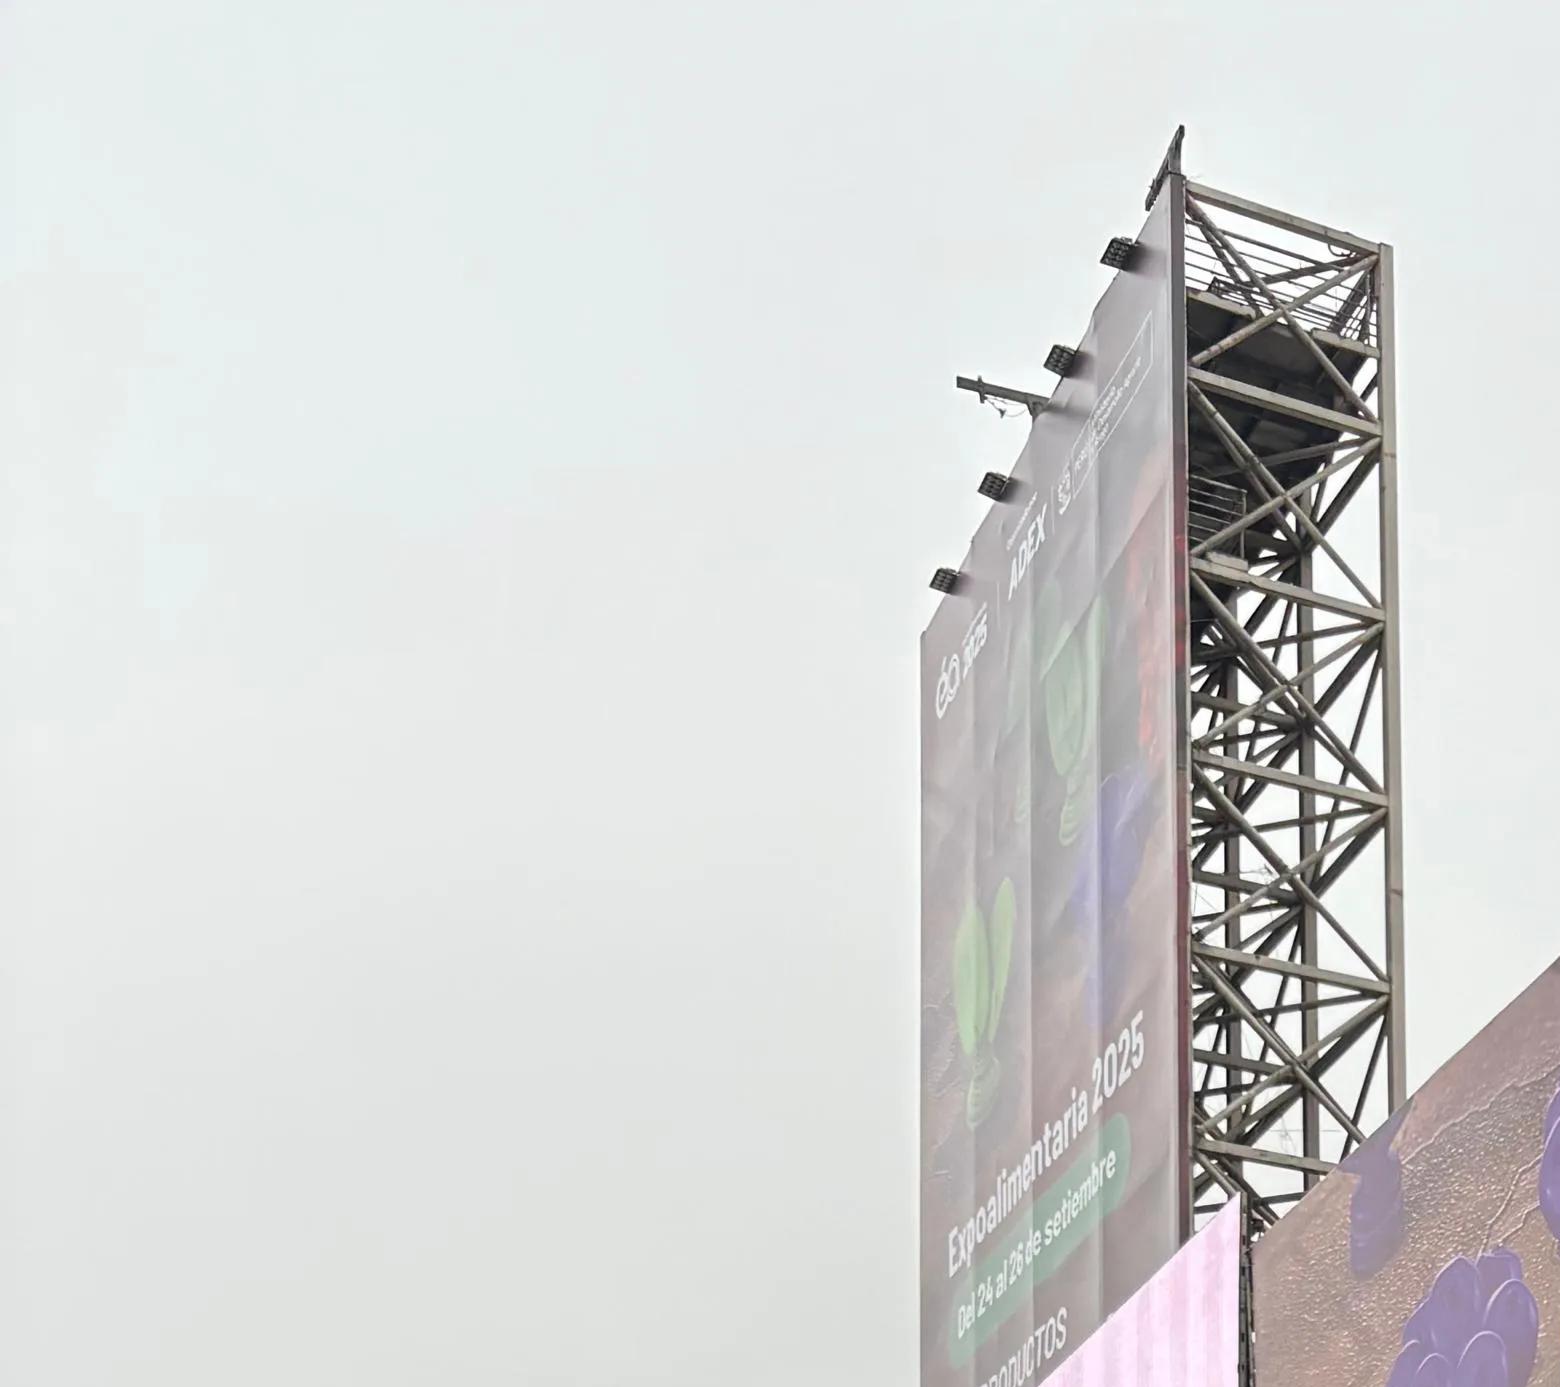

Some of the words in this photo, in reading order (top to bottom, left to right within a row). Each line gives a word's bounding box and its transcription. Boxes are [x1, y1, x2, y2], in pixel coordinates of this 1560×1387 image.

[1007, 503, 1047, 601] ADEX
[948, 1086, 1088, 1278] Expoalimentaria
[1091, 1010, 1145, 1115] 2025
[958, 1300, 976, 1340] Del
[977, 1276, 993, 1318] 24
[996, 1259, 1008, 1298] al
[1009, 1241, 1023, 1286] 26
[1025, 1228, 1041, 1266] de
[1044, 1149, 1116, 1246] setiembre
